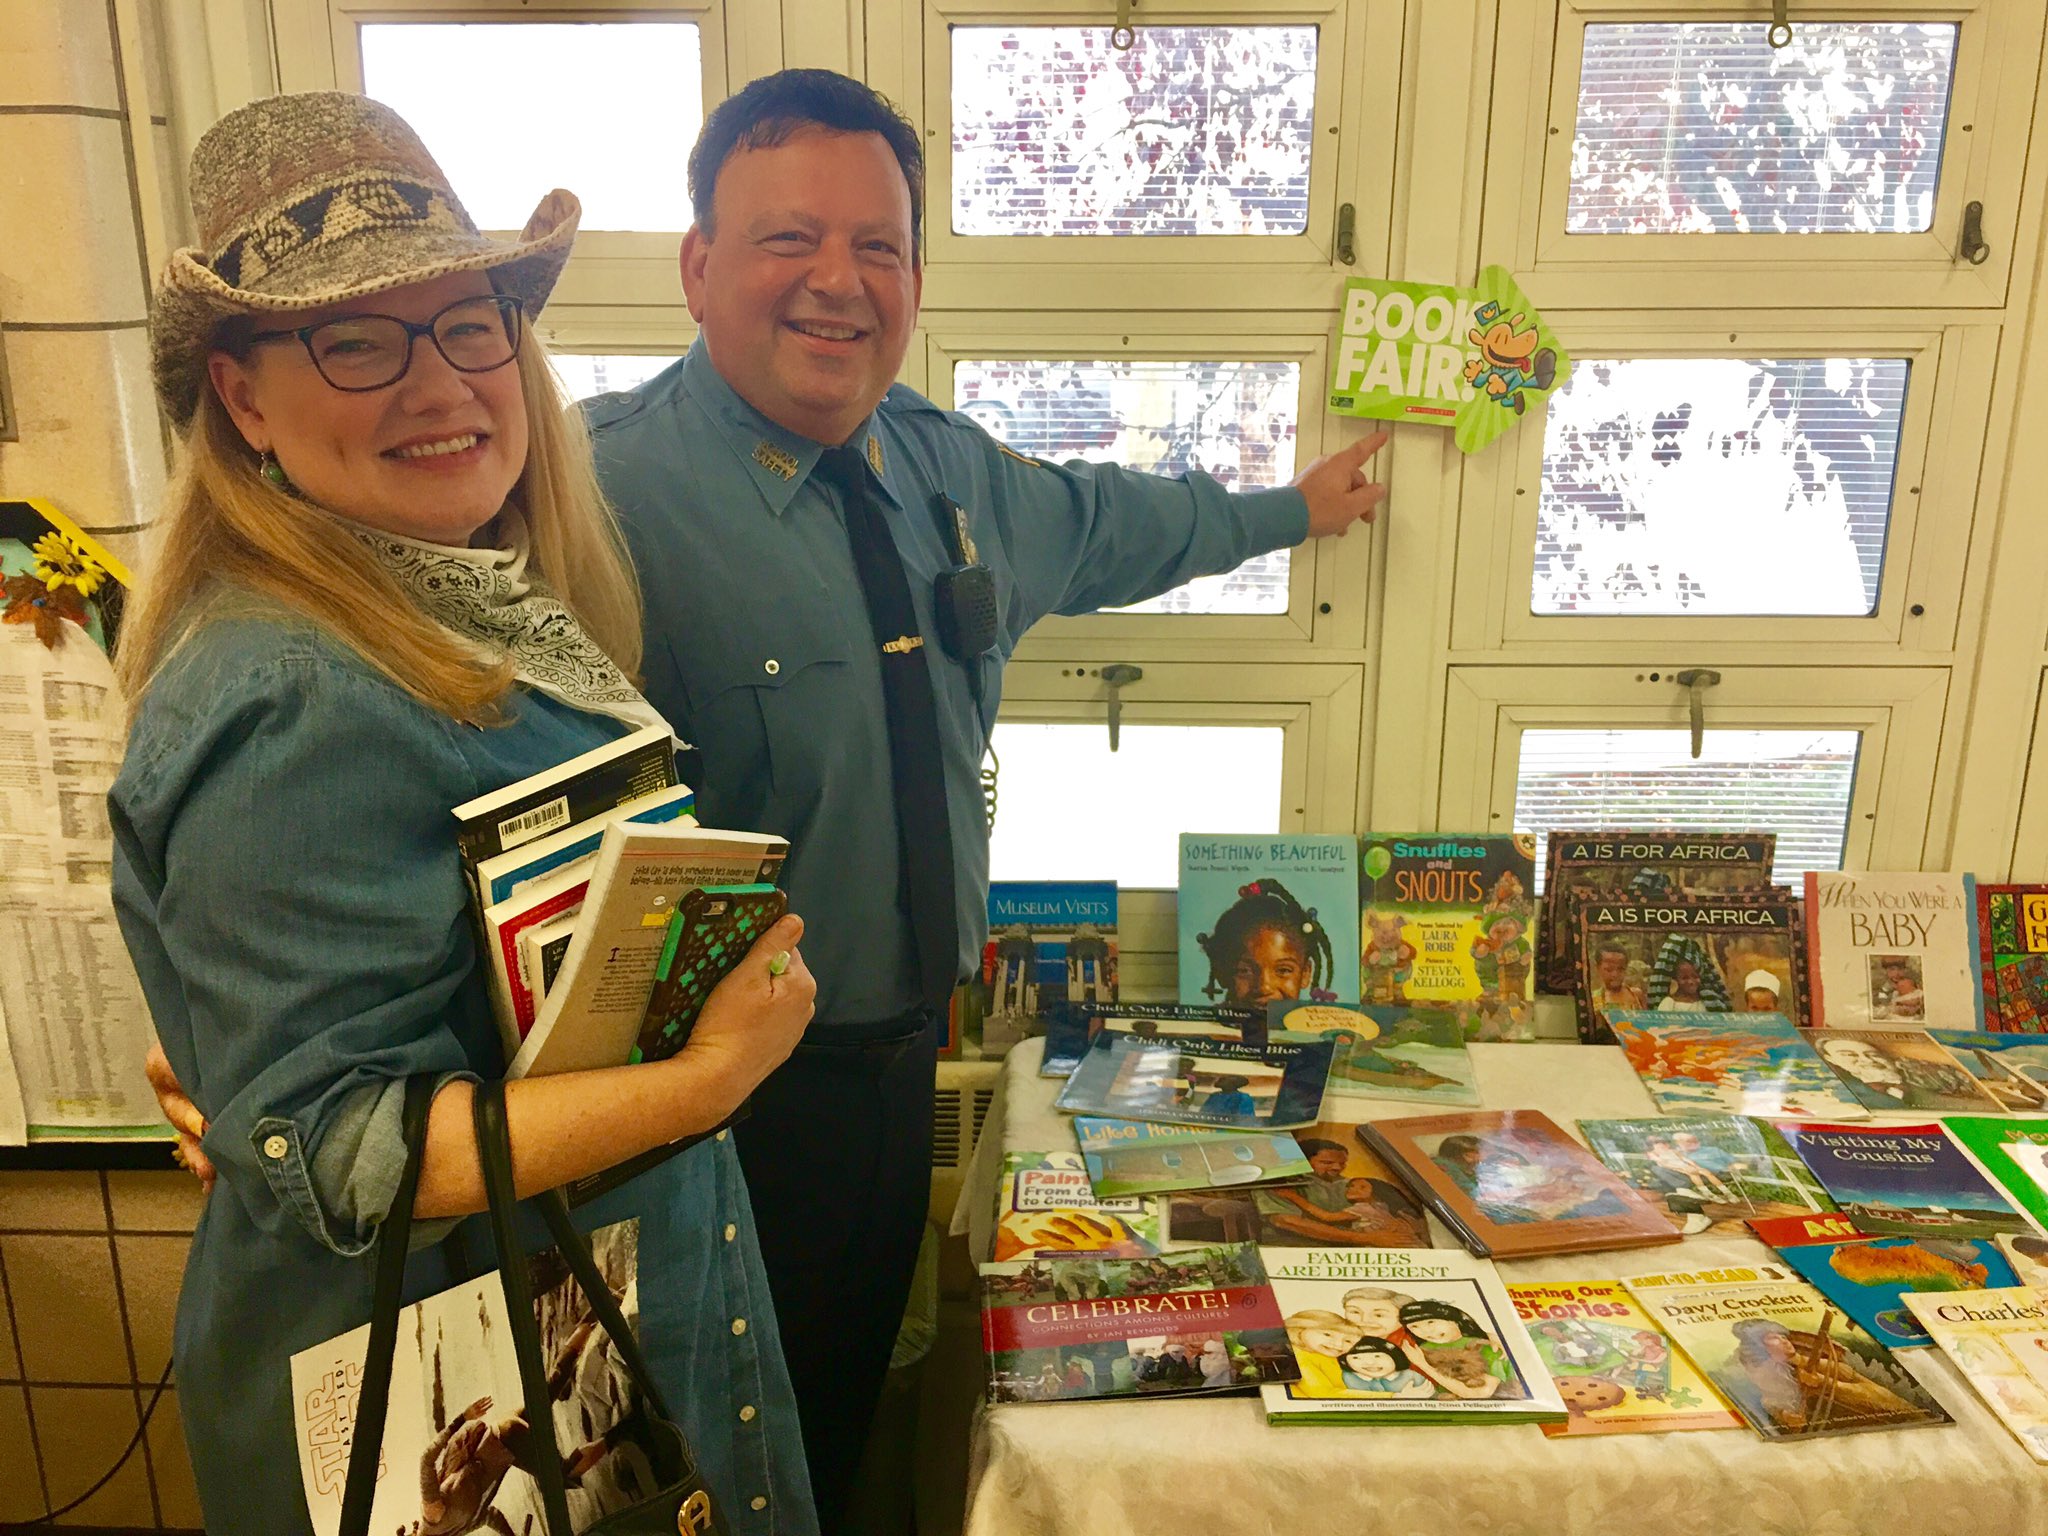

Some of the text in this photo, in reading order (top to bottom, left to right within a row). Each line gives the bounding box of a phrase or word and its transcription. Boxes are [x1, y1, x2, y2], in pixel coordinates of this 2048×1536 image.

[1343, 288, 1487, 347] BOOK
[751, 448, 798, 482] SAFETY
[1185, 843, 1347, 861] SOMETHING BEAUTIFUL
[1393, 842, 1487, 858] Snuffles
[1573, 844, 1750, 860] A IS FOR AFRICA
[1426, 858, 1453, 870] and
[1394, 870, 1483, 903] SNOUTS
[1953, 895, 1962, 910] A
[1597, 908, 1776, 925] A IS FOR AFRICA
[1422, 930, 1458, 941] LAURA
[1850, 912, 1938, 947] BABY
[1424, 942, 1455, 953] ROBB
[1417, 966, 1461, 977] STEVEN
[1413, 977, 1466, 988] KELLOGG
[1081, 1003, 1252, 1019] Chidi Only Likes Blue
[1622, 1010, 1779, 1024] Herman the Helper
[1123, 1034, 1167, 1047] Chidi
[1172, 1038, 1214, 1051] Only
[1219, 1041, 1261, 1053] Likes
[1265, 1045, 1302, 1055] Blue
[1082, 1125, 1139, 1140] Like
[1616, 1123, 1648, 1134] The
[1650, 1121, 1708, 1133] Saddest
[1799, 1133, 1943, 1152] Visiting My
[1832, 1148, 1936, 1164] Cousins
[1024, 1186, 1071, 1197] From
[1023, 1196, 1133, 1209] to Computers
[1802, 1218, 1859, 1239] Afr
[1307, 1252, 1412, 1265] FAMILIES
[1276, 1265, 1450, 1278] ARE DIFFERENT
[1577, 1285, 1614, 1298] Our
[1026, 1292, 1231, 1324] CELEBRATE!
[1512, 1298, 1631, 1320] Stories
[1662, 1303, 1718, 1317] Davy
[1722, 1294, 1808, 1311] Crockett
[1937, 1302, 2045, 1323] Charles
[1031, 1310, 1231, 1335] CONNECTIONS AMONG CULTURES
[1676, 1305, 1815, 1326] A Life on the Frontier
[1087, 1325, 1180, 1340] BY JAN REYNOLDS
[334, 1359, 346, 1399] JEDI
[1424, 1402, 1437, 1410] by
[305, 1371, 347, 1507] STAR
